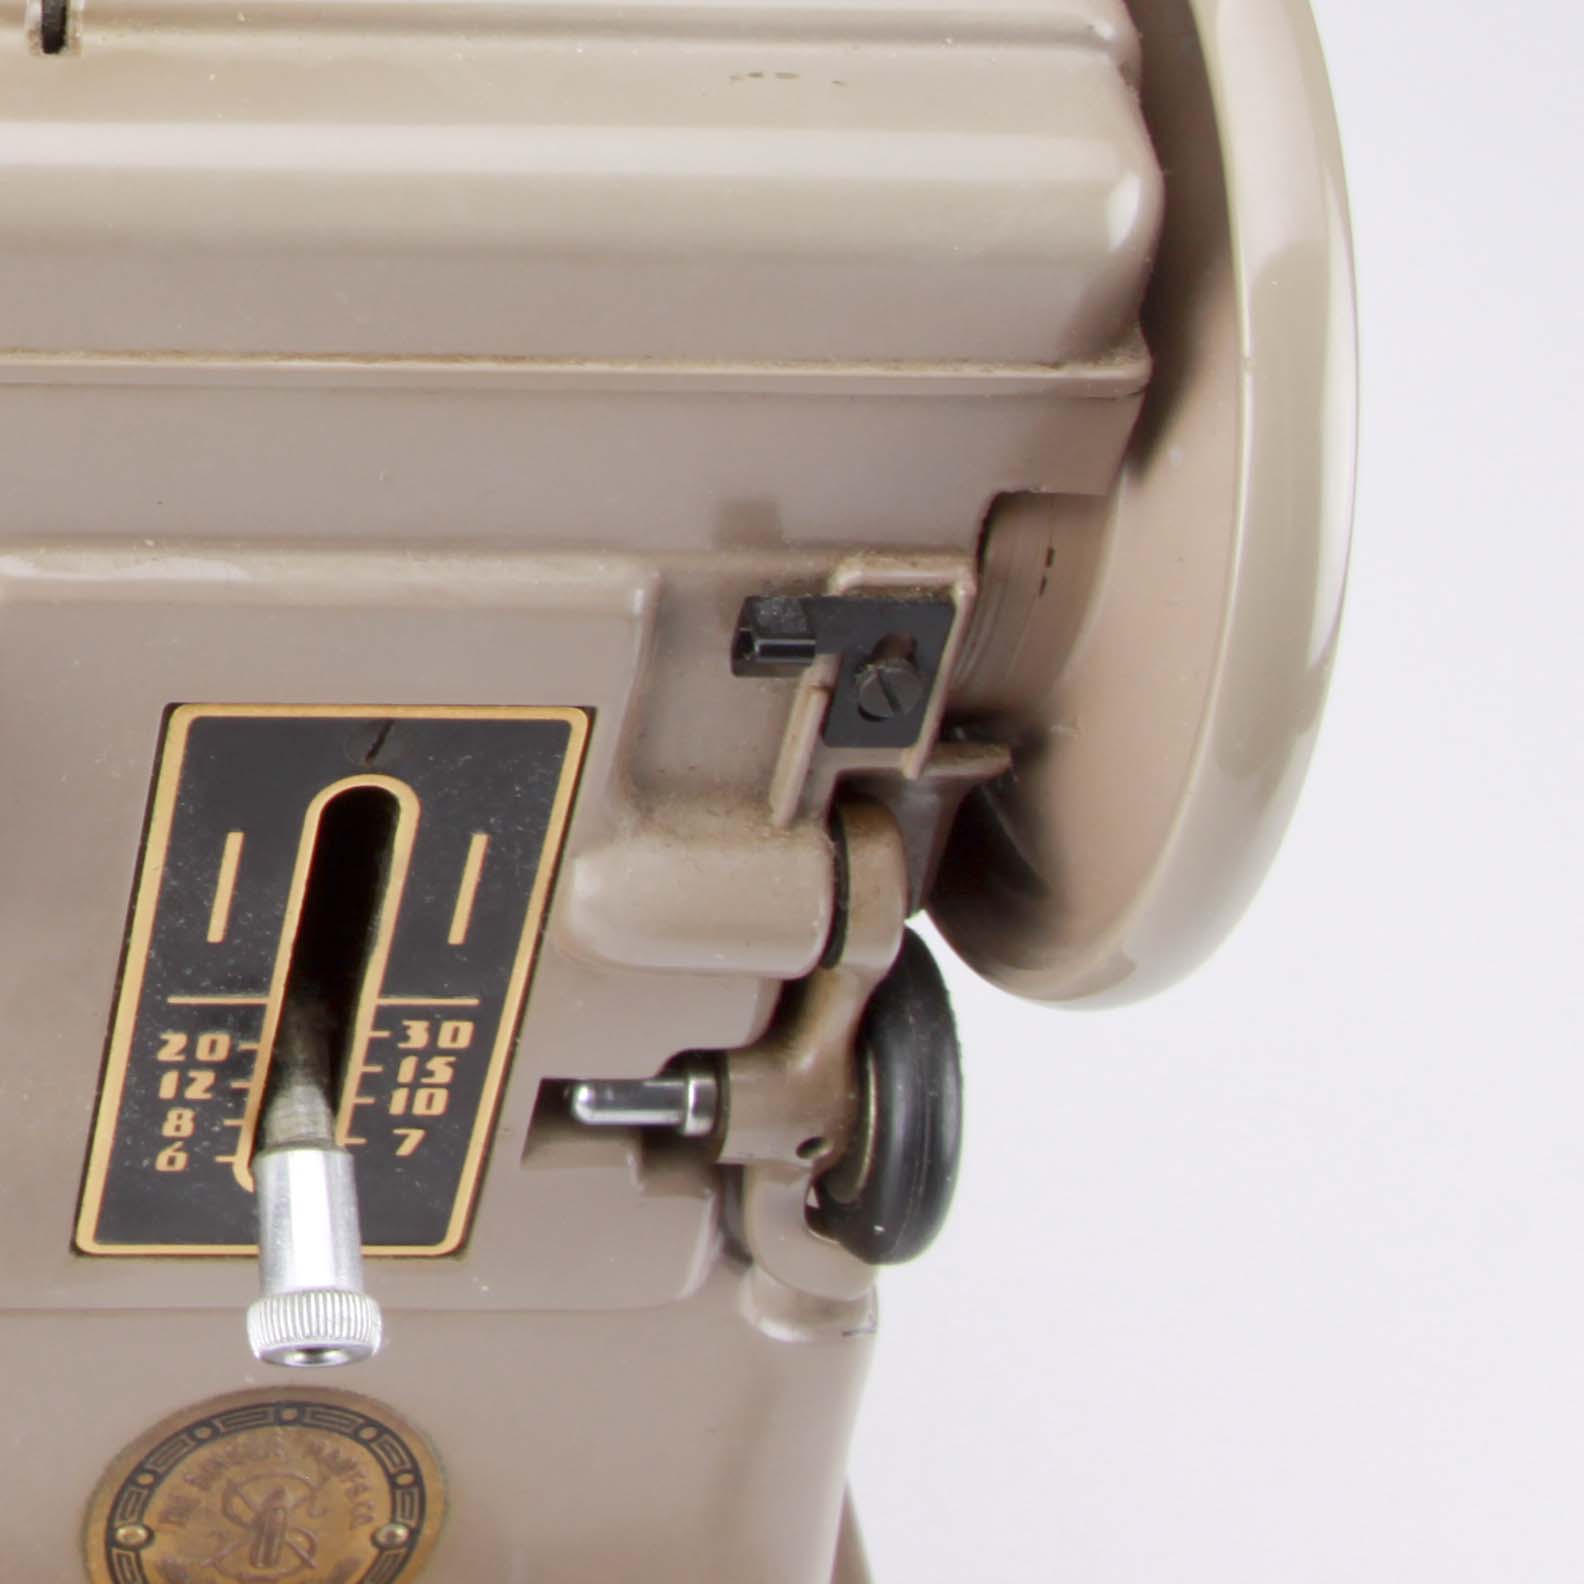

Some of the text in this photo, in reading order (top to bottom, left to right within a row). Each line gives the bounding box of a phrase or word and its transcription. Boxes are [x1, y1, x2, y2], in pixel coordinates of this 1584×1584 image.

[156, 1029, 231, 1062] 20
[397, 1020, 474, 1049] 30
[158, 1069, 215, 1100] 12
[396, 1055, 456, 1085] 15
[388, 1087, 449, 1116] 10
[161, 1106, 195, 1138] 8
[155, 1140, 188, 1172] 6
[393, 1128, 425, 1156] 7
